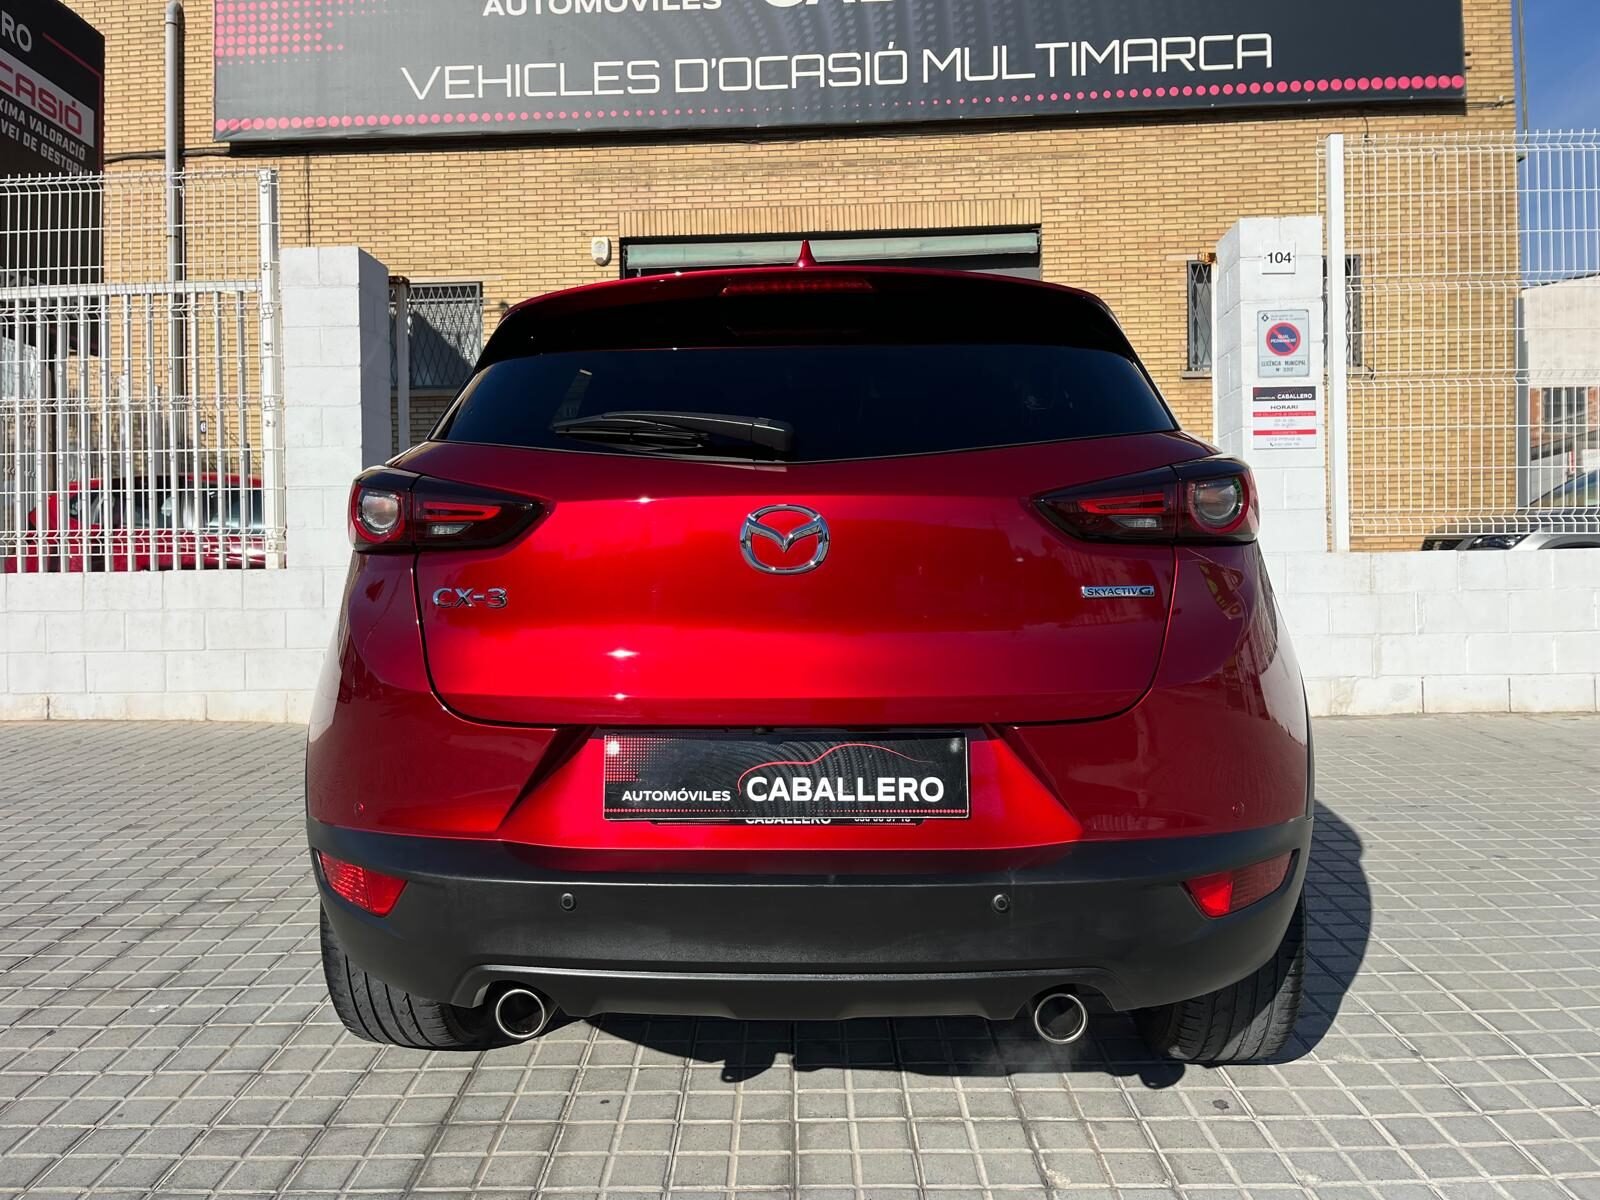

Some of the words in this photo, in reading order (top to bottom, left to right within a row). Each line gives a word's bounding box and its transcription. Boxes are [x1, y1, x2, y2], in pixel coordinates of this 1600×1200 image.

[1, 9, 33, 52] RO
[400, 60, 661, 100] VEHICLES
[674, 41, 908, 93] D'OCASIÓ
[922, 33, 1273, 84] MULTIMARCA
[22, 131, 39, 153] DE
[29, 114, 86, 161] VALORACIÓ
[1266, 251, 1292, 264] 104
[432, 587, 508, 608] CX-3
[1087, 587, 1138, 596] SKYACTIV
[622, 788, 731, 802] AUTOMÓVILES
[746, 776, 945, 802] CABALLERO
